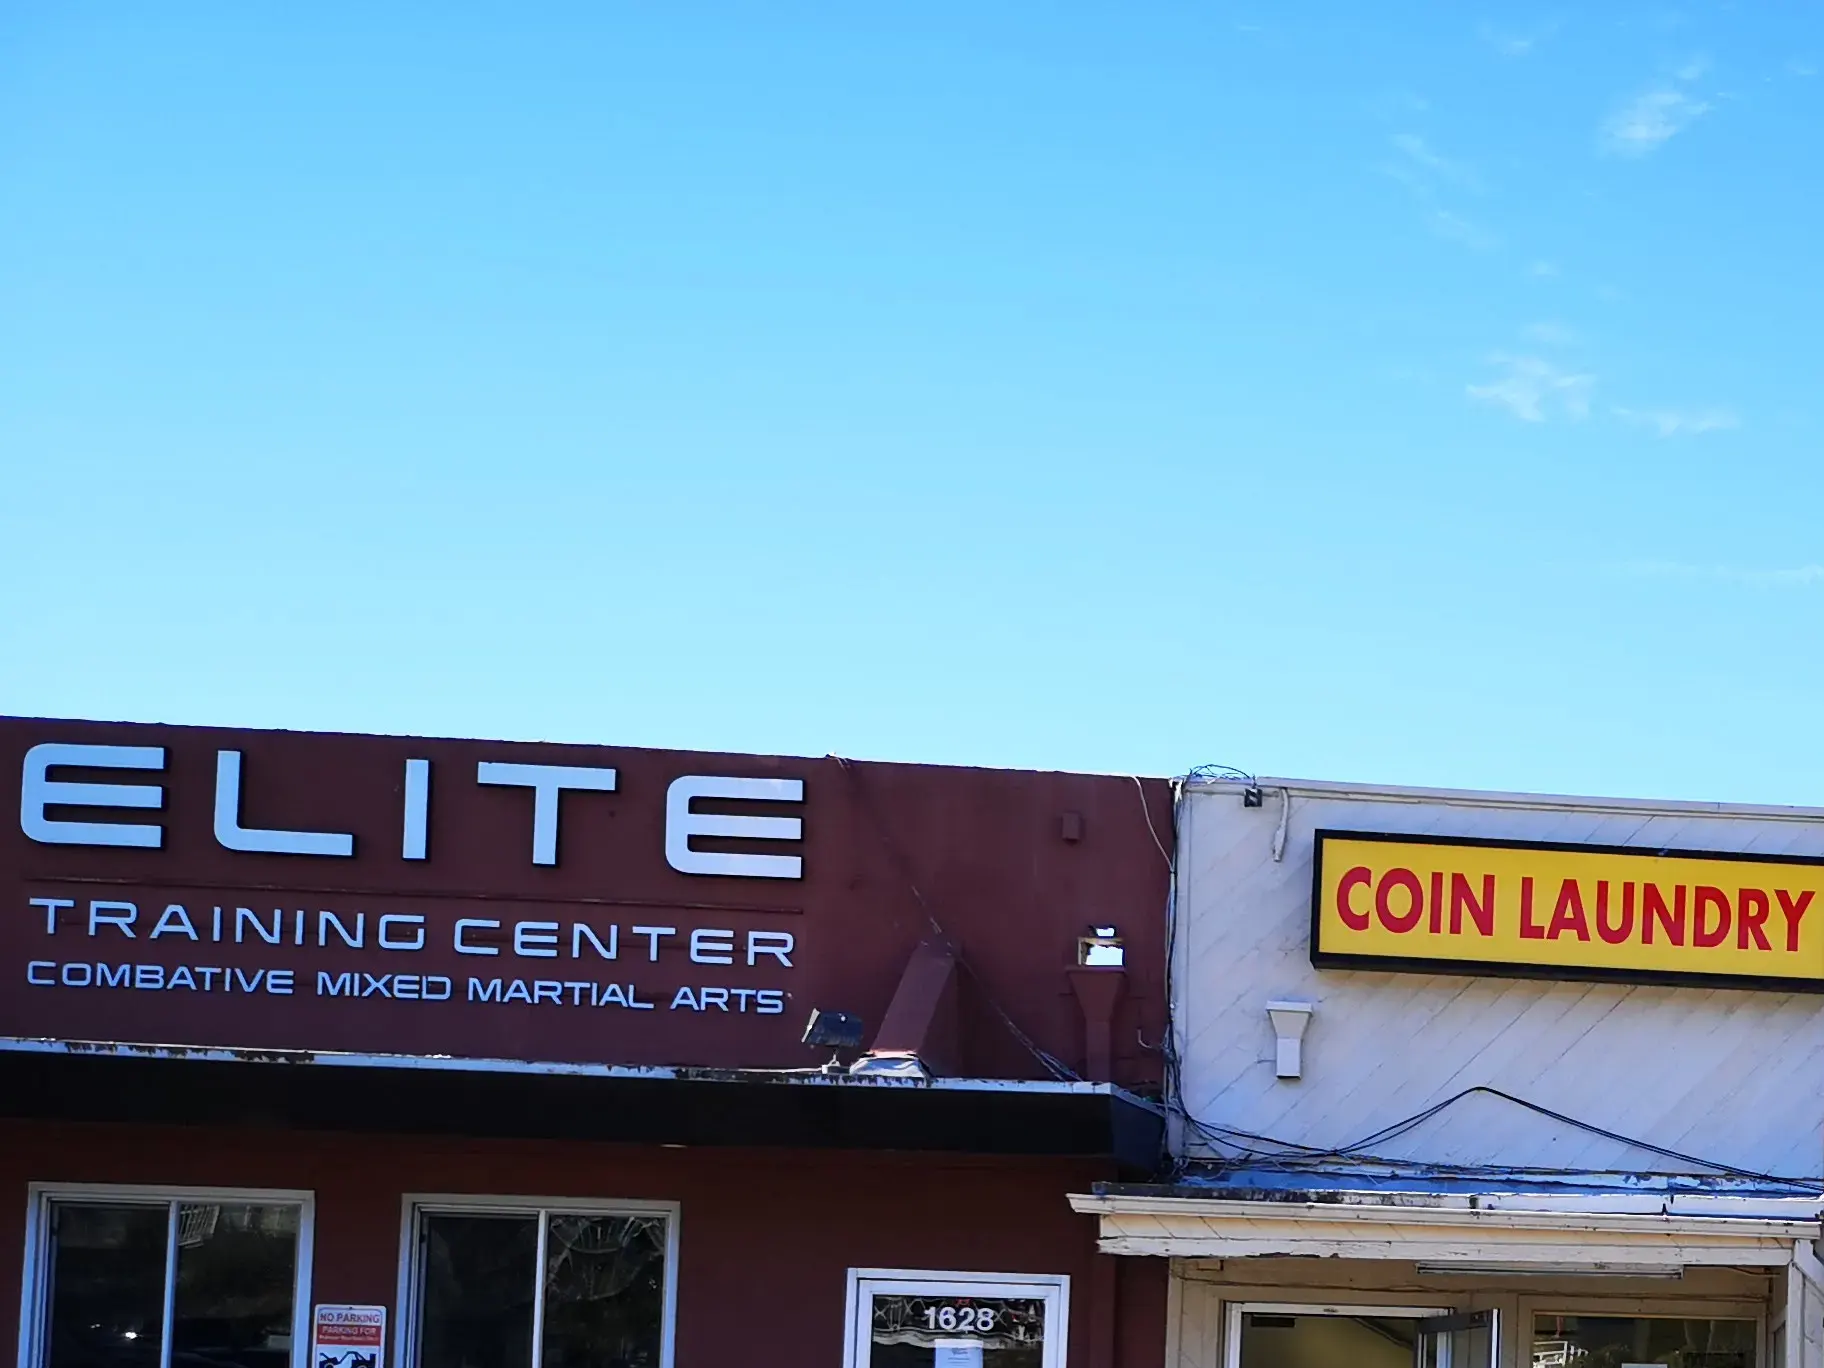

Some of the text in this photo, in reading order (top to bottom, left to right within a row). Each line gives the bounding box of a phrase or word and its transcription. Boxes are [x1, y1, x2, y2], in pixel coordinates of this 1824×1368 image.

[20, 742, 804, 880] ELITE
[28, 896, 796, 968] TRAINING CENTER
[1336, 865, 1816, 952] COIN LAUNDRY
[26, 960, 785, 1015] COMBATIVE MIXED MARTIAL ARTS
[319, 1313, 381, 1324] NO PARKING
[359, 1327, 377, 1335] FOR
[924, 1306, 995, 1332] 1628
